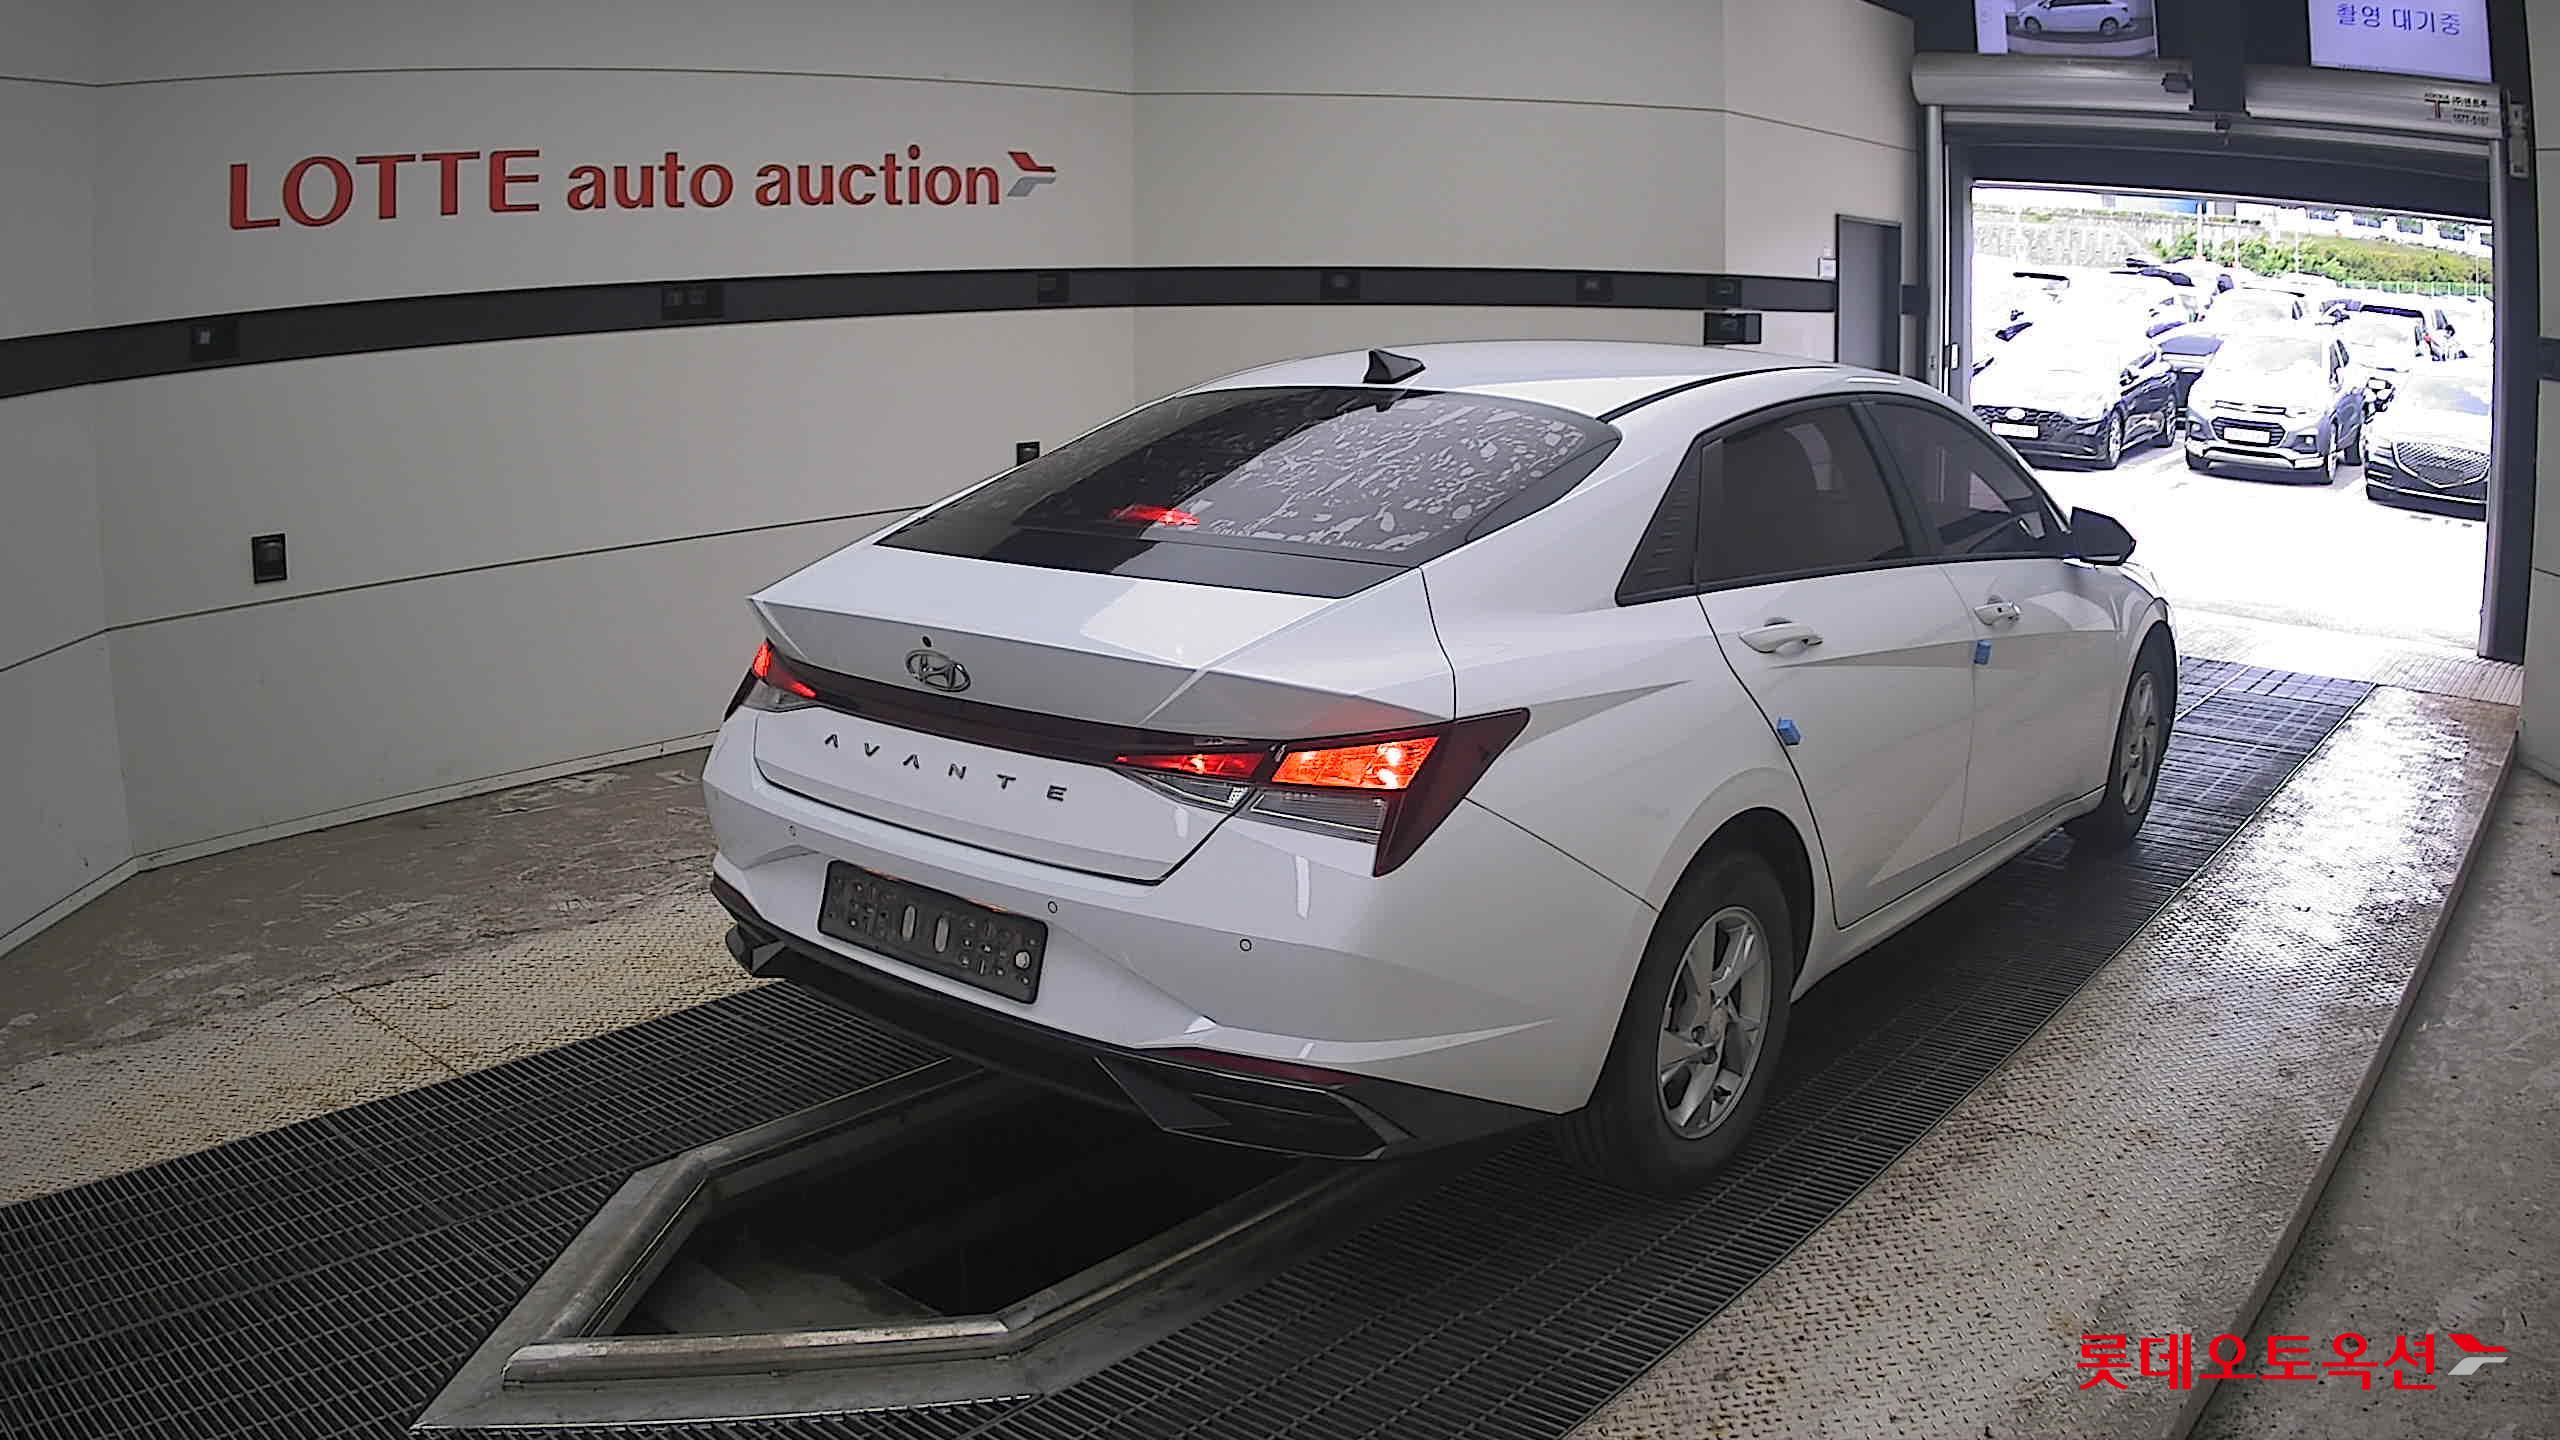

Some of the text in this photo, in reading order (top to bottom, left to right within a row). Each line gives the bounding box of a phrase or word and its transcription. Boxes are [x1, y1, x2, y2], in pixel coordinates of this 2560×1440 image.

[2336, 3, 2460, 36] 촬영 대기중
[230, 146, 1001, 230] LOTTE auto auction
[824, 733, 1069, 803] AVANTE
